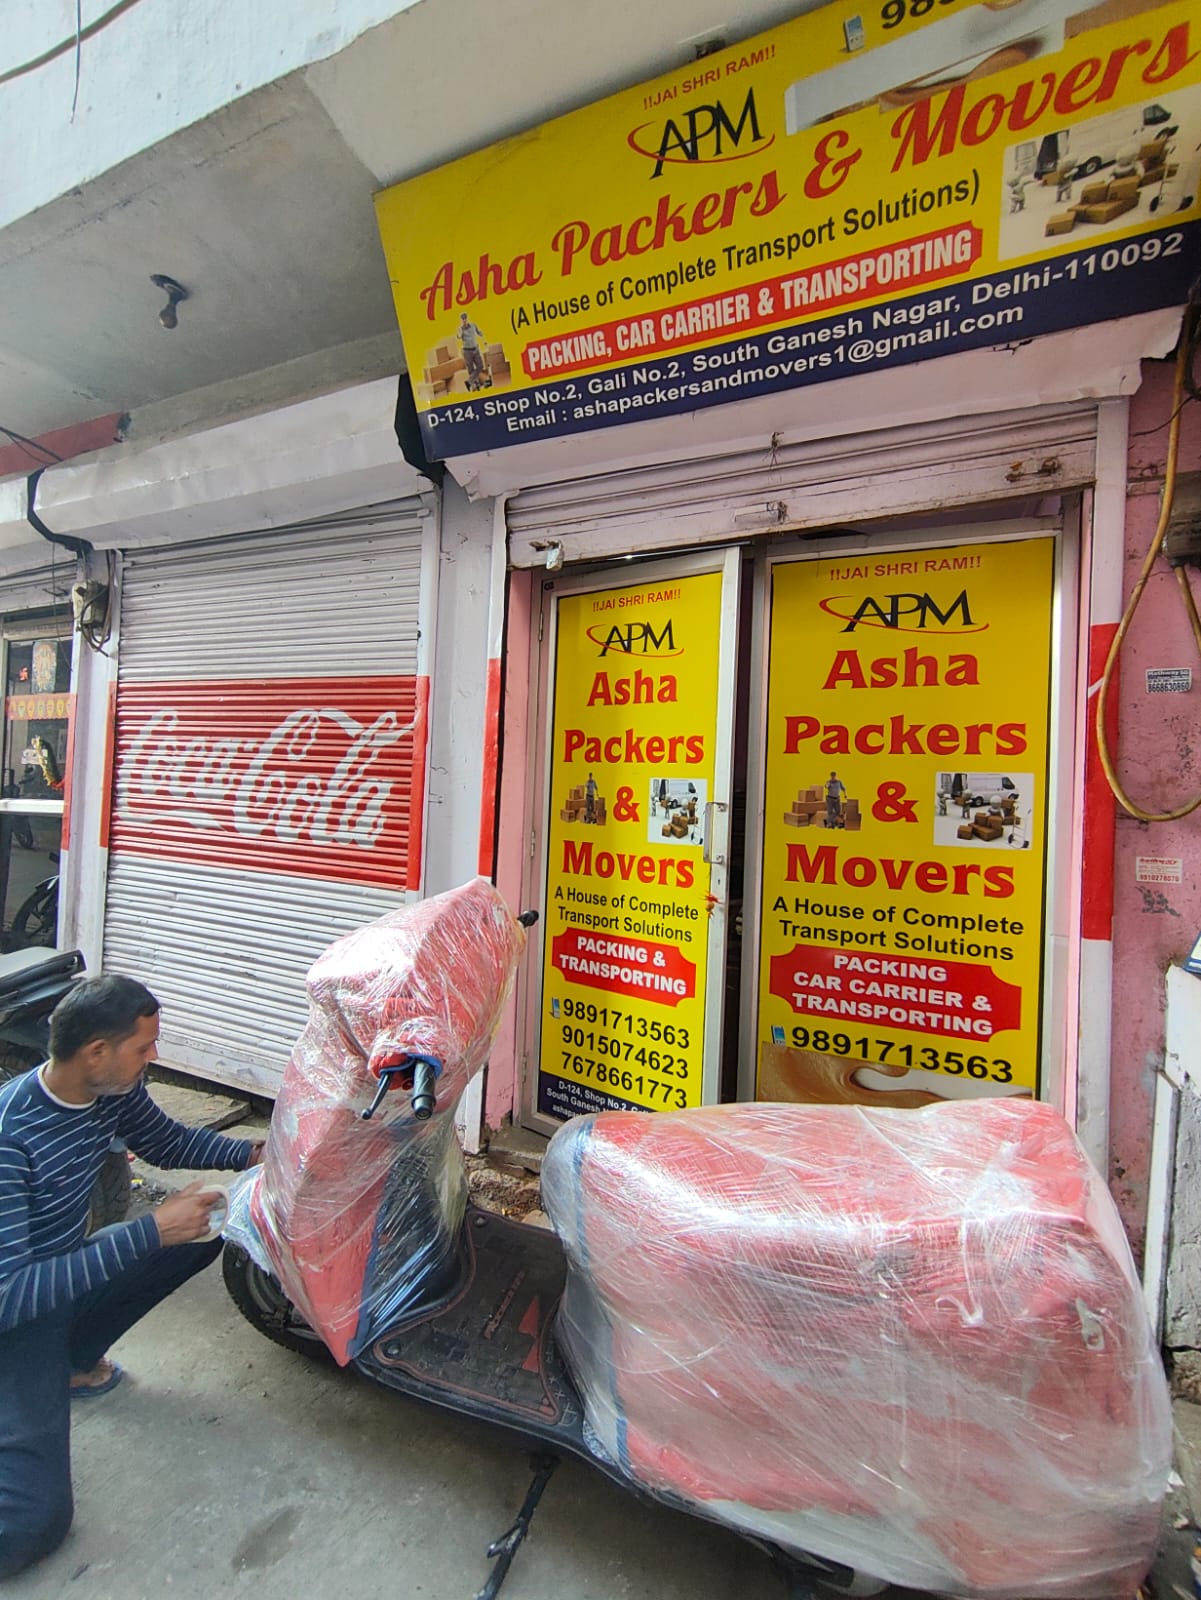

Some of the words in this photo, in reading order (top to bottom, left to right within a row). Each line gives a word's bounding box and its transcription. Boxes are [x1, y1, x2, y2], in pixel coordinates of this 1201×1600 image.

[881, 0, 955, 29] 98
[682, 67, 721, 94] SHRI
[725, 44, 776, 77] RAM!!
[649, 86, 765, 180] APM
[419, 251, 543, 321] Asha
[551, 169, 788, 277] Packers
[803, 129, 863, 199] &
[890, 21, 1201, 174] Movers
[510, 303, 529, 334] (A
[533, 289, 590, 325] House
[596, 281, 615, 307] of
[619, 256, 716, 302] Complete
[723, 215, 835, 272] Transport
[843, 169, 979, 236] Solutions)
[528, 331, 612, 372] PACKING,
[616, 319, 657, 352] CAR
[660, 297, 750, 342] CARRIER
[757, 287, 774, 315] &
[781, 229, 972, 311] TRANSPORTING
[427, 406, 480, 429] D-124,
[484, 395, 530, 419] Shop
[535, 382, 583, 406] No.2,
[587, 371, 627, 395] Gali
[632, 360, 686, 384] No.2,
[692, 344, 759, 373] South
[767, 315, 864, 354] Ganesh
[873, 294, 961, 333] Nagar,
[972, 231, 1184, 304] Delhi-110092
[506, 409, 557, 433] Email
[562, 410, 569, 422] :
[573, 305, 1024, 421] ashapackersandmovers1@gmail.com
[830, 566, 869, 581] !!JAI
[874, 561, 918, 577] SHRI
[924, 556, 981, 572] RAM!!
[592, 597, 616, 612] !!JAI
[618, 593, 644, 608] SHRI
[647, 588, 681, 603] RAM!!
[839, 589, 978, 633] APM
[597, 618, 678, 658] APM
[587, 668, 678, 707] Asha
[822, 646, 980, 690] Asha
[563, 728, 704, 764] Packers
[783, 714, 1028, 756] Packers
[613, 786, 641, 823] &
[871, 781, 919, 823] &
[562, 840, 694, 889] Movers
[784, 843, 1016, 899] Movers
[554, 885, 564, 900] A
[567, 887, 607, 909] House
[611, 894, 626, 910] of
[629, 895, 699, 921] Complete
[772, 895, 788, 912] A
[795, 898, 865, 920] House
[872, 906, 896, 923] of
[903, 908, 1024, 936] Complete
[558, 906, 619, 932] Transport
[623, 918, 693, 943] Solutions
[779, 919, 887, 947] Transport
[894, 932, 1015, 961] Solutions
[577, 935, 648, 964] PACKING
[652, 950, 666, 968] &
[833, 954, 947, 982] PACKING
[559, 953, 687, 996] TRANSPORTING
[793, 972, 842, 991] CAR
[849, 979, 963, 1009] CARRIER
[971, 995, 993, 1012] &
[563, 998, 690, 1050] 9891713563
[792, 992, 993, 1036] TRANSPORTING
[562, 1025, 689, 1079] 9015074623
[791, 1026, 1014, 1083] 9891713563
[546, 1087, 569, 1103] South
[570, 1096, 601, 1113] Ganesh
[558, 1080, 583, 1098] D-124,
[584, 1089, 606, 1105] Shop
[561, 1051, 688, 1110] 7678661773
